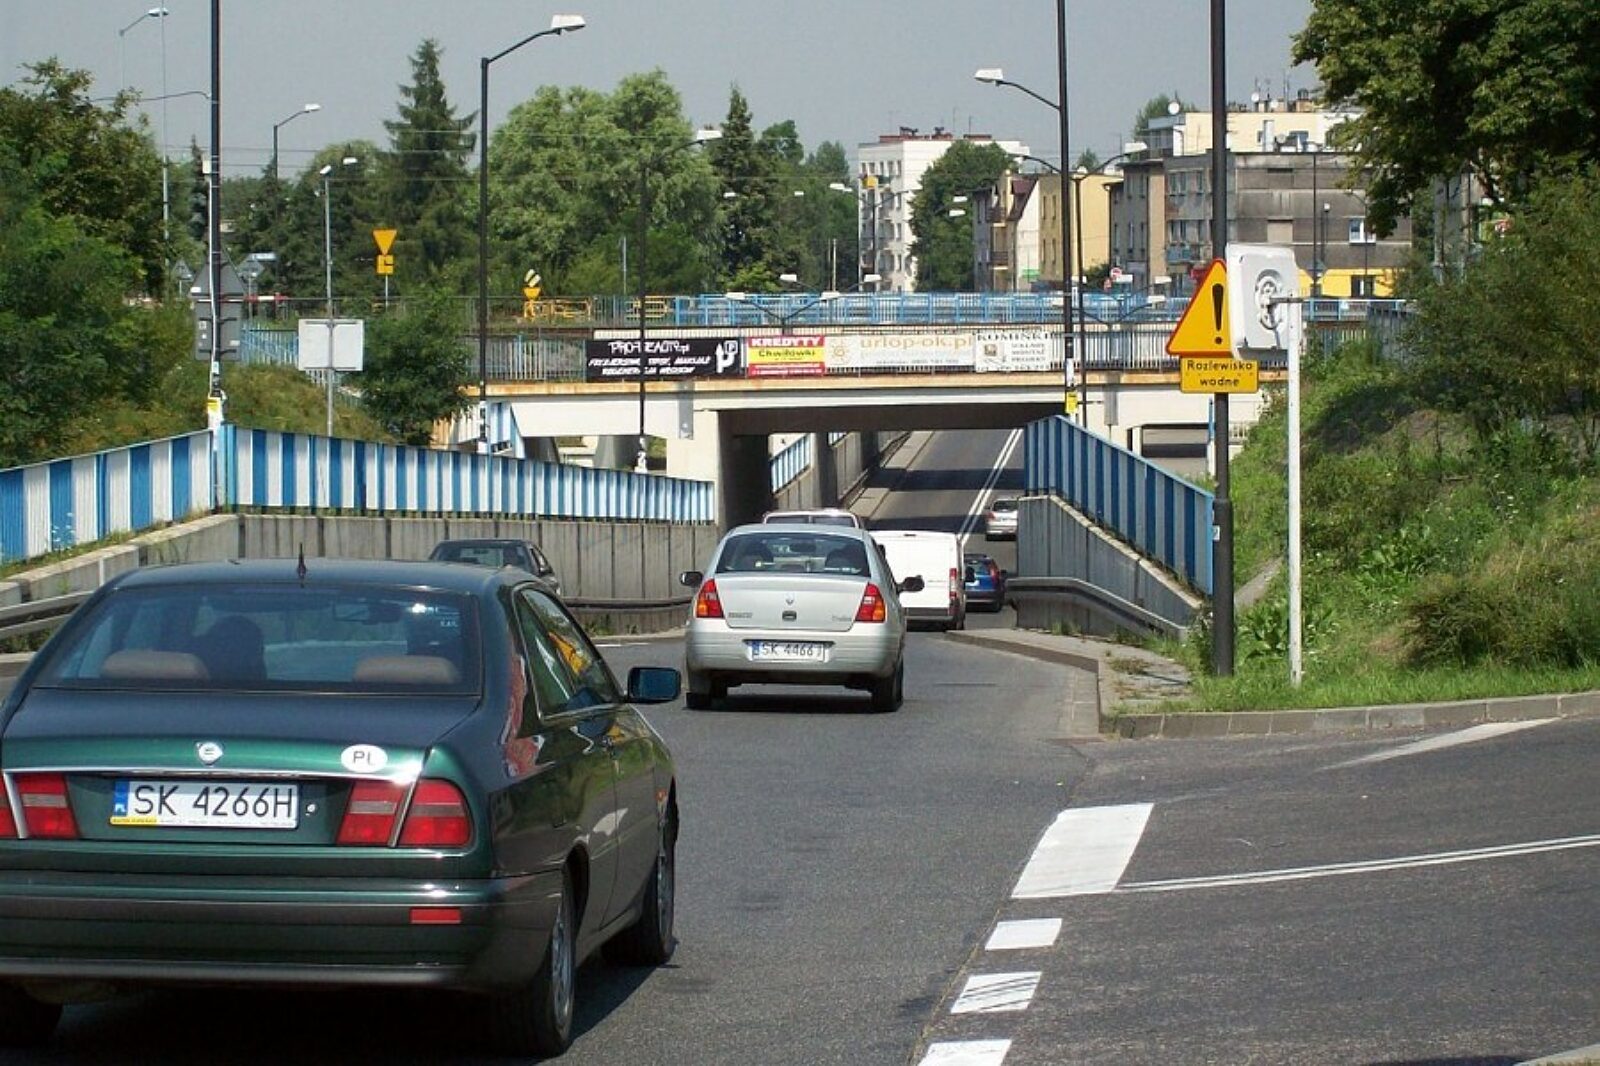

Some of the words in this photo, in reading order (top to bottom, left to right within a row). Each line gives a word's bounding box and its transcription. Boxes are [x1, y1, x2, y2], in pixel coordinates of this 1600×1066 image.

[751, 336, 820, 347] KREDYTY
[861, 335, 972, 350] urlop-ok.pl
[1187, 360, 1253, 371] Rozlewisko
[1200, 376, 1239, 387] wodne
[762, 642, 778, 655] SK
[353, 750, 376, 766] PL
[134, 784, 179, 816] SK
[192, 786, 293, 818] 4266H
